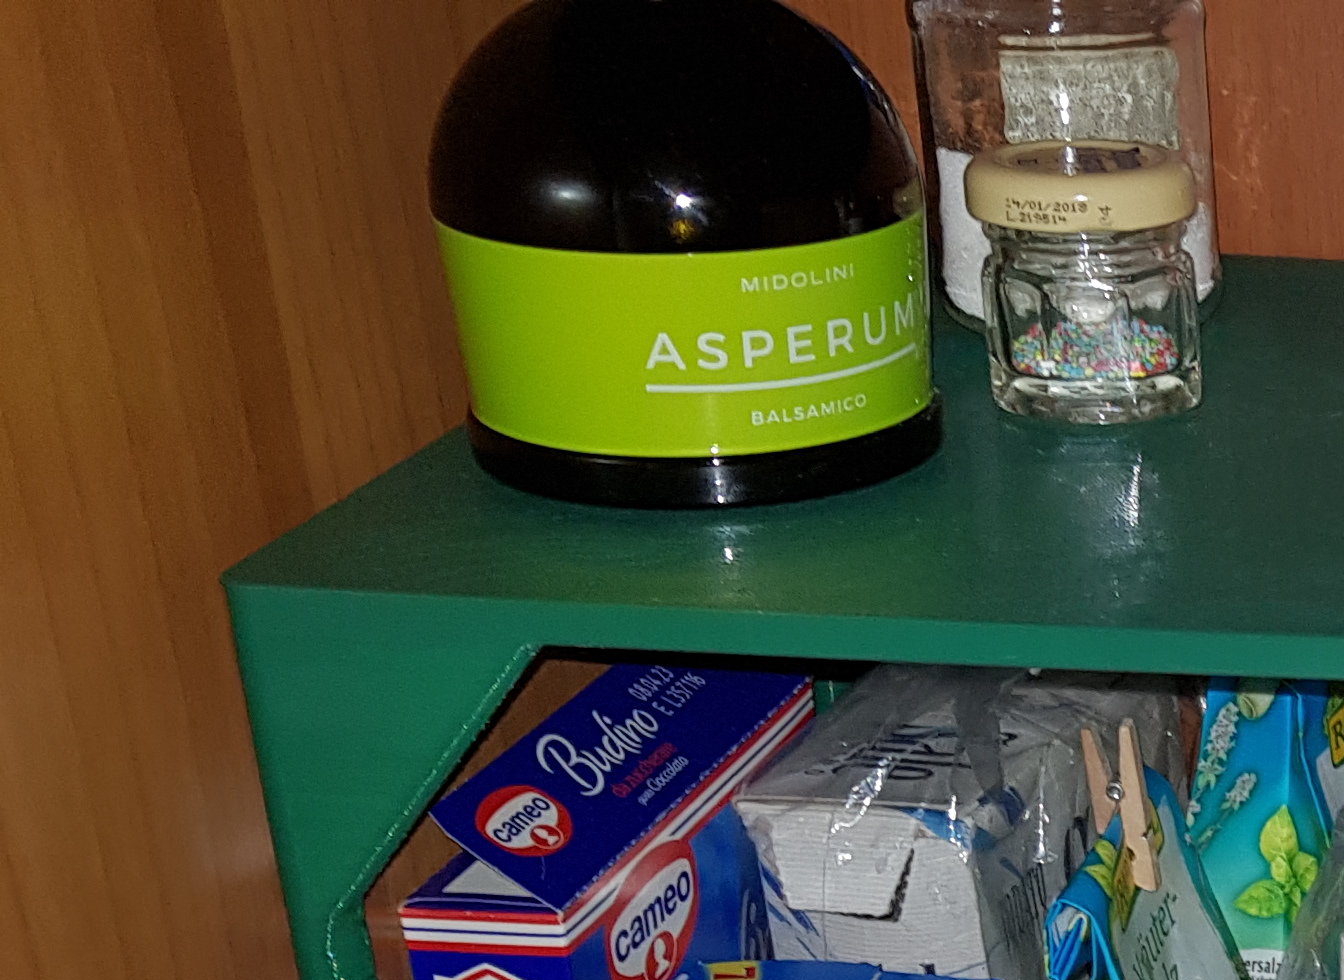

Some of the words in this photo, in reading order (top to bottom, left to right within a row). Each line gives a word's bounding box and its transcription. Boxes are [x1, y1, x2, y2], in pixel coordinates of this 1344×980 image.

[740, 264, 854, 293] MIDOLINI
[646, 293, 915, 370] ASPERUM
[751, 394, 867, 426] BALSAMICO
[535, 708, 660, 797] Budino
[492, 796, 551, 844] cameo
[615, 870, 691, 962] cameo
